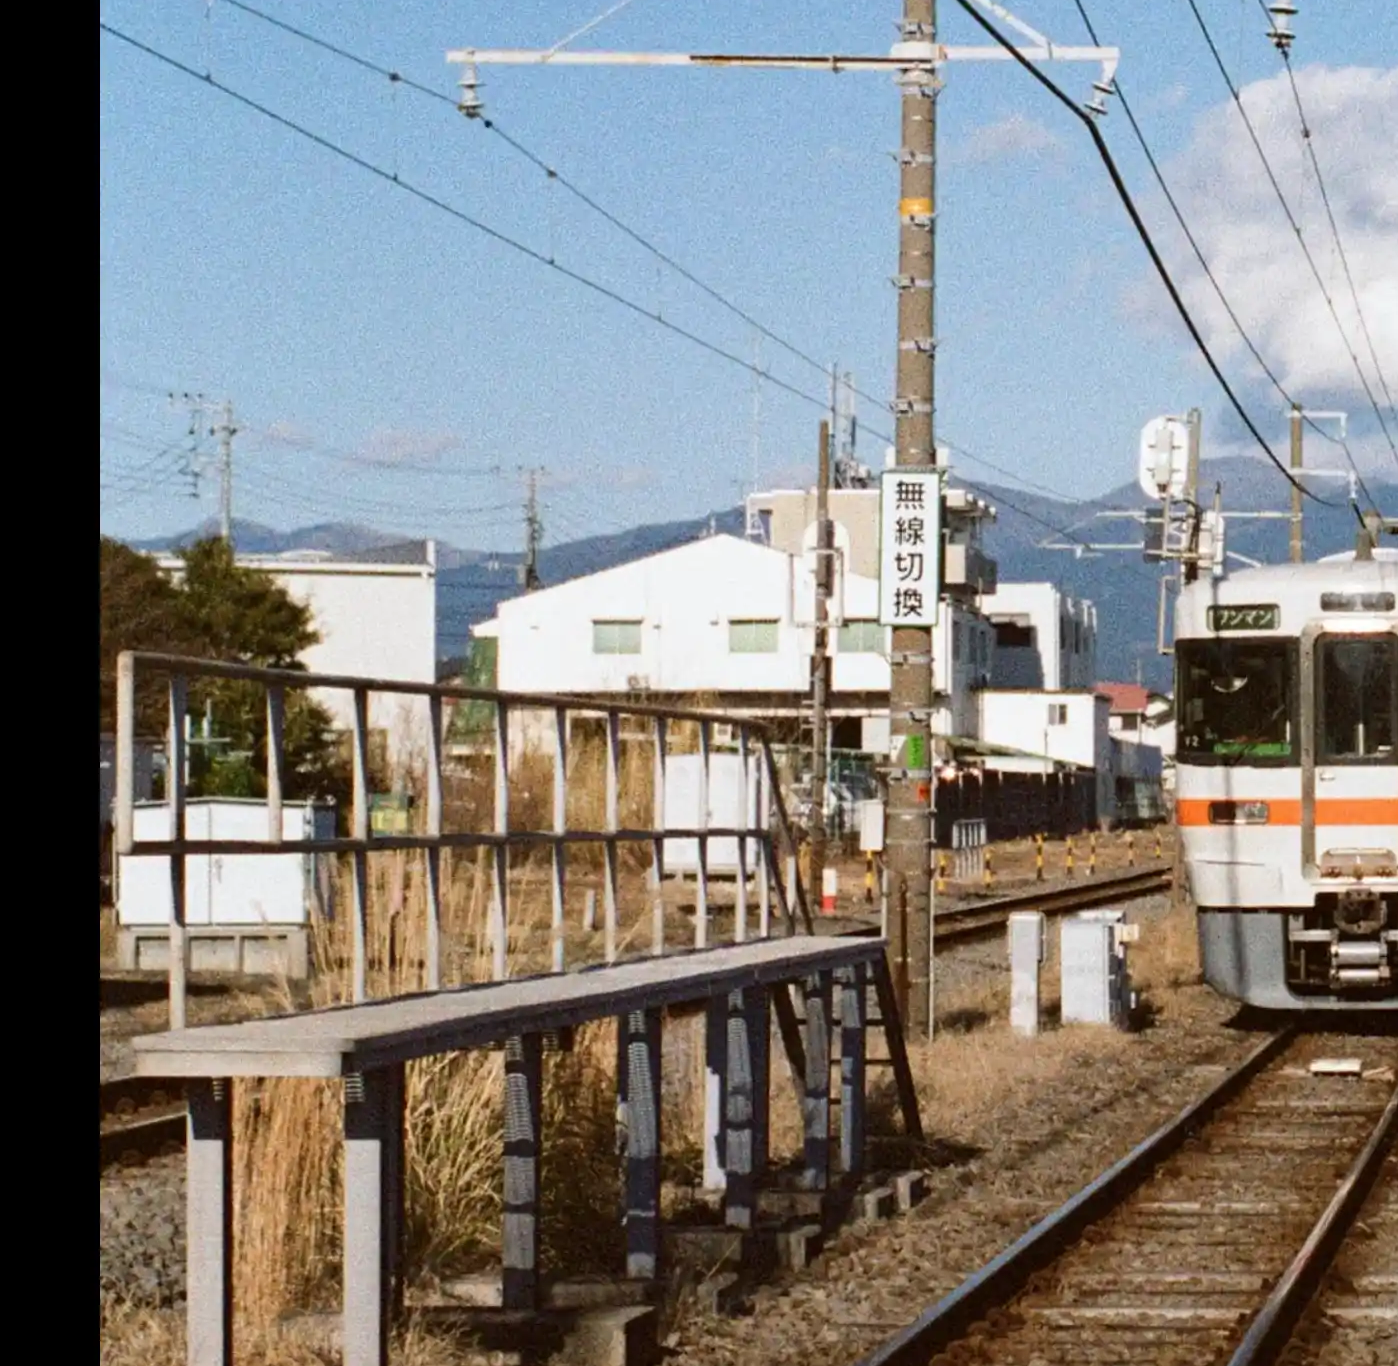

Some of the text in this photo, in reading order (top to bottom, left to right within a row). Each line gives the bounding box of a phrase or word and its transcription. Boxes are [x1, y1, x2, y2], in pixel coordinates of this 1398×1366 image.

[893, 479, 926, 618] 無線切換
[1216, 609, 1273, 626] ワンマン
